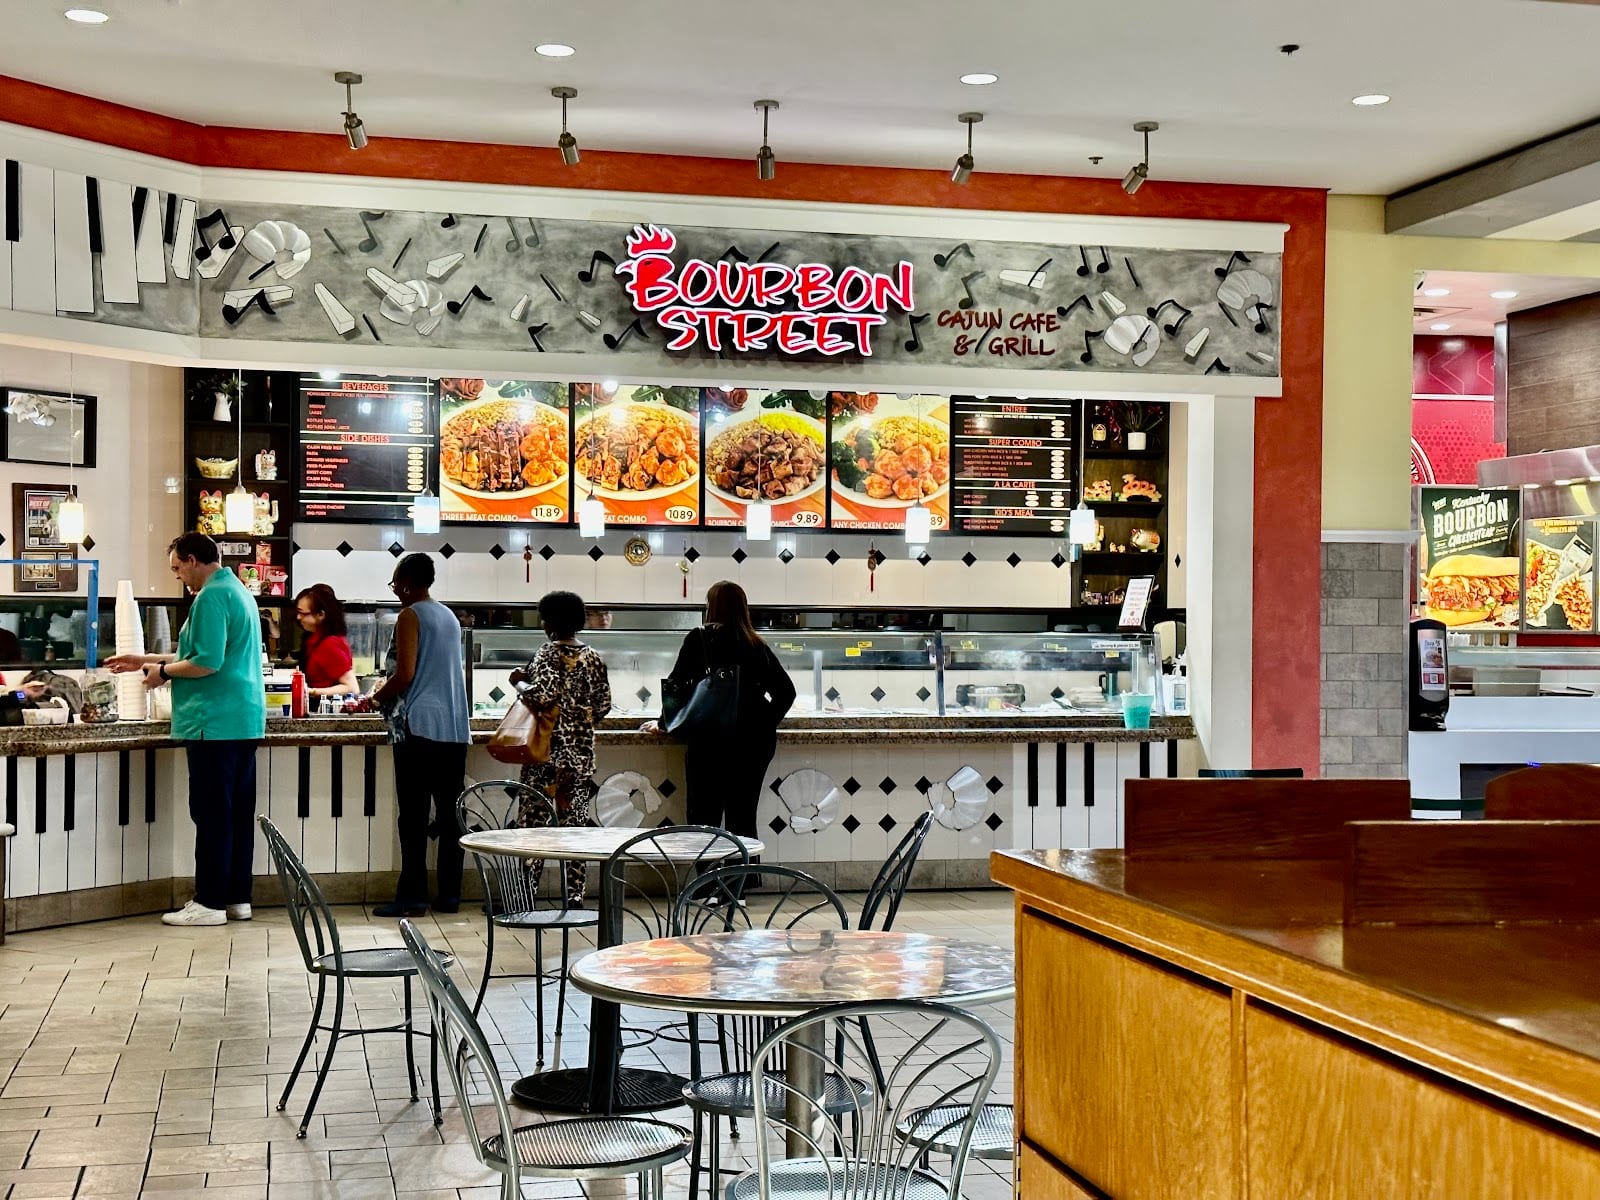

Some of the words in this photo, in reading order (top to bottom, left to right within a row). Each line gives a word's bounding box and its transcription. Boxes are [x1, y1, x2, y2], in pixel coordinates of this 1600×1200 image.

[616, 252, 915, 312] BOURBON
[937, 308, 1003, 330] CAJUN
[1009, 312, 1061, 334] CAFE
[657, 305, 888, 357] STREET
[953, 334, 977, 356] &
[342, 382, 389, 391] BEVERAGES
[1001, 405, 1028, 413] ENTREE
[340, 434, 360, 442] SIDE
[362, 434, 390, 443] DISHES
[989, 438, 1011, 446] SUPER
[1012, 439, 1042, 447] COMBO
[1012, 481, 1036, 489] CARTE
[1452, 491, 1490, 510] Kentucky
[442, 512, 465, 522] THREE
[466, 512, 486, 522] MEAT
[487, 513, 519, 523] COMBO
[534, 507, 560, 518] 11.89
[994, 509, 1014, 517] KID'S
[1014, 510, 1035, 518] MEAL
[617, 515, 647, 524] COMBO
[796, 513, 819, 524] 9.89
[1433, 498, 1509, 539] BOURBON
[771, 520, 789, 528] OMBO
[833, 521, 849, 529] ANY
[850, 521, 881, 530] CHICKEN
[883, 522, 905, 530] COMB
